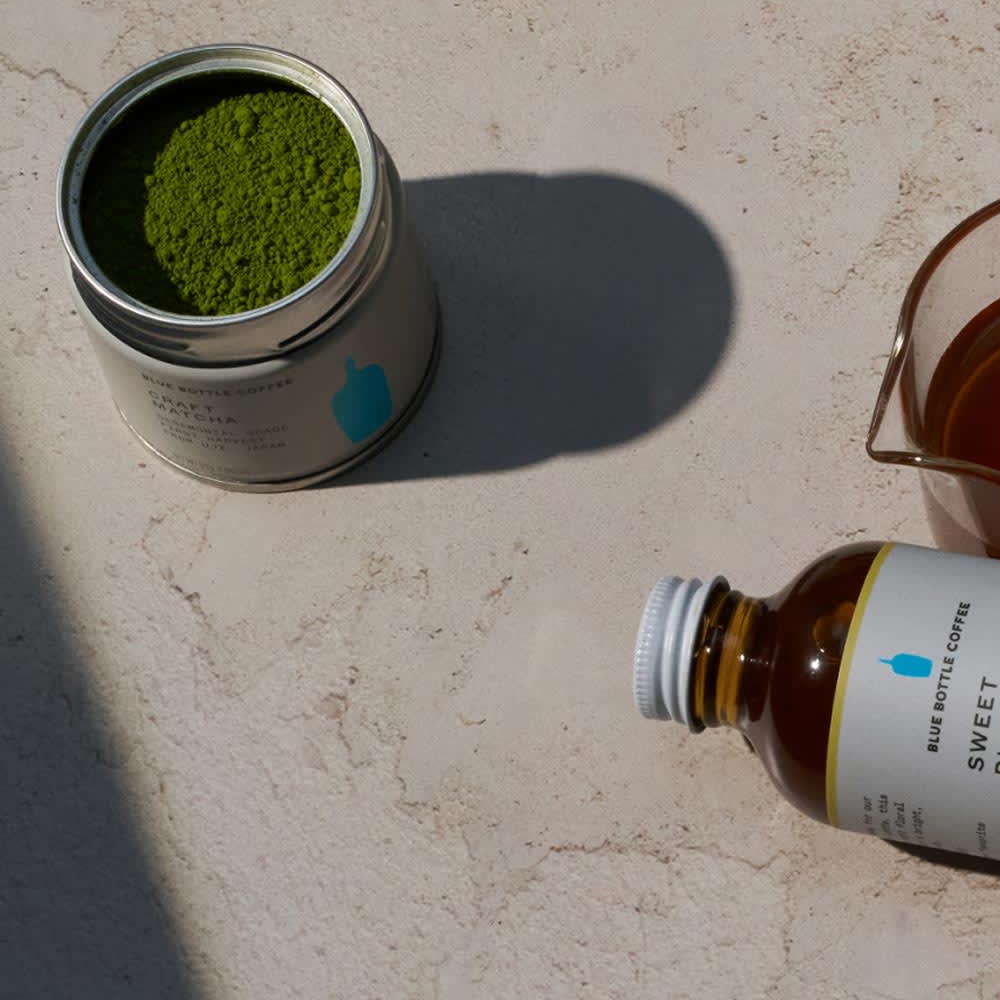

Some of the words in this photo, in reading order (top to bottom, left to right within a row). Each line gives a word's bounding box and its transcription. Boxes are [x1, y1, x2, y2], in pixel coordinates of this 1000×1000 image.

[946, 601, 971, 652] COFFEE
[933, 656, 955, 711] BOTTLE
[927, 715, 943, 752] BLUE
[967, 676, 998, 772] SWEET
[878, 794, 888, 813] this
